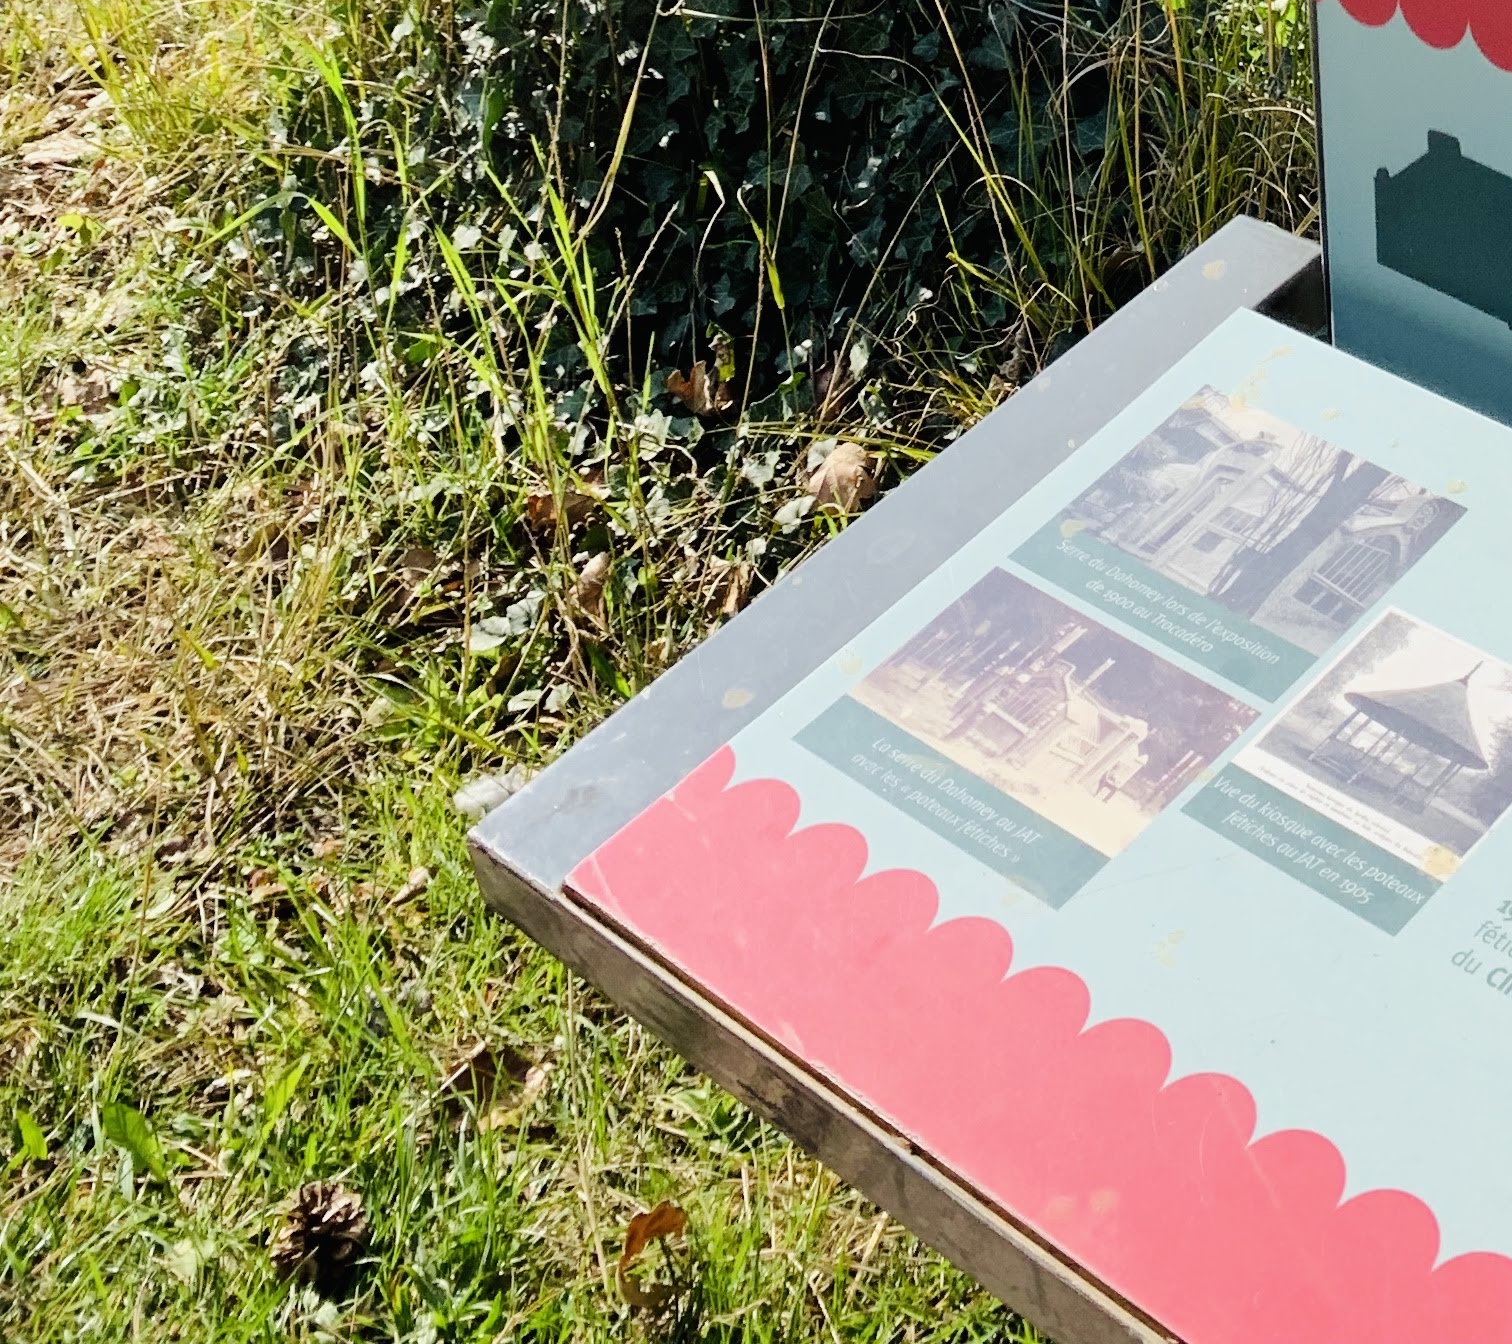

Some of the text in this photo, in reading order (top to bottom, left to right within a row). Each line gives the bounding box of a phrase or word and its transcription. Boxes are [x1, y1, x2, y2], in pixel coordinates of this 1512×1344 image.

[1055, 538, 1091, 562] Serre
[1087, 557, 1106, 572] du
[1104, 565, 1166, 603] Dahomey
[1161, 595, 1190, 616] lors
[1186, 611, 1208, 626] de
[1084, 579, 1215, 653] de 1900 au Trocadéro
[871, 736, 892, 754] La
[918, 768, 941, 785] du
[936, 778, 1000, 821] Dahomey
[995, 816, 1017, 833] au
[1010, 825, 1044, 845] JAT
[879, 769, 903, 788] les
[904, 789, 962, 827] poteaux
[955, 819, 1012, 858] fétiches
[1213, 775, 1242, 798] Vue
[1237, 792, 1261, 810] du
[1256, 800, 1314, 840] kiosque
[1309, 835, 1345, 859] avec
[1341, 850, 1369, 872] les
[1360, 865, 1426, 905] poteaux
[1220, 809, 1376, 905] fétiches au JAT en 1905
[1450, 948, 1484, 976] du
